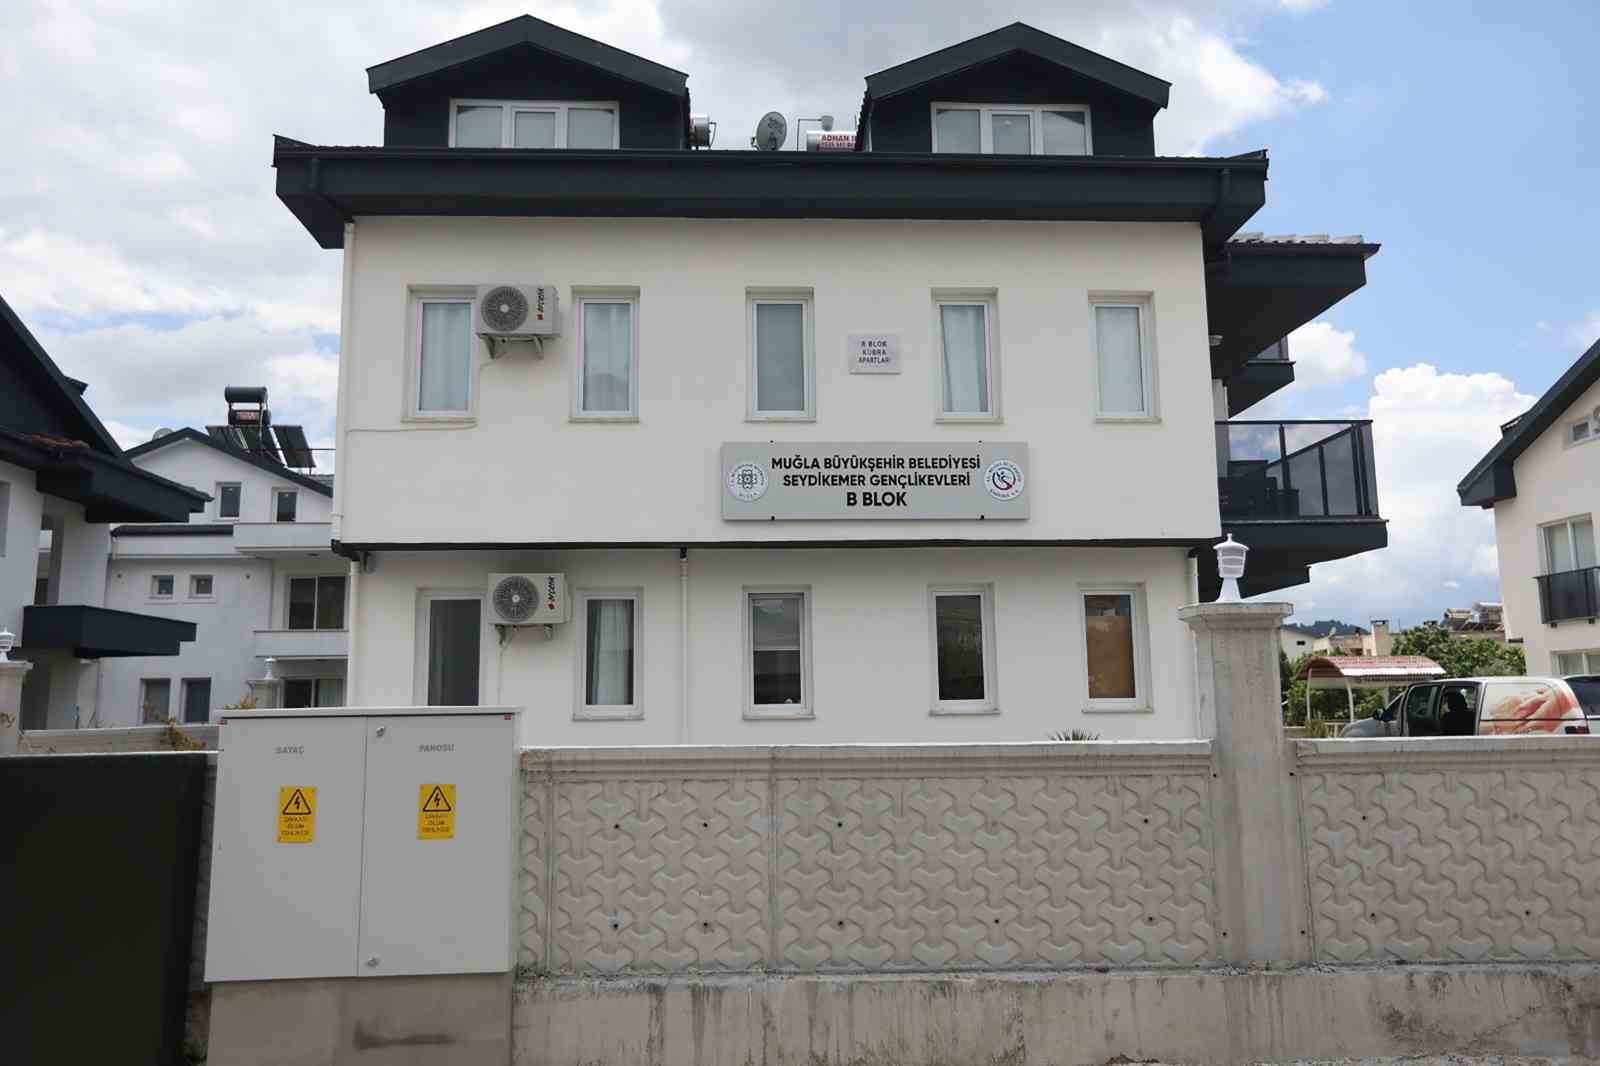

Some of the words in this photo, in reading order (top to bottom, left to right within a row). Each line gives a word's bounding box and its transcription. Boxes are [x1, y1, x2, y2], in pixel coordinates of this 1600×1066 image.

[771, 455, 820, 469] MUĞLA
[823, 455, 905, 472] BÜYÜKŞEHİR
[908, 454, 980, 469] BELEDİYESİ
[783, 471, 866, 486] SEYDİKEMER
[869, 471, 971, 488] GENÇLİKEVLERİ
[846, 492, 858, 506] B
[862, 491, 907, 506] BLOK
